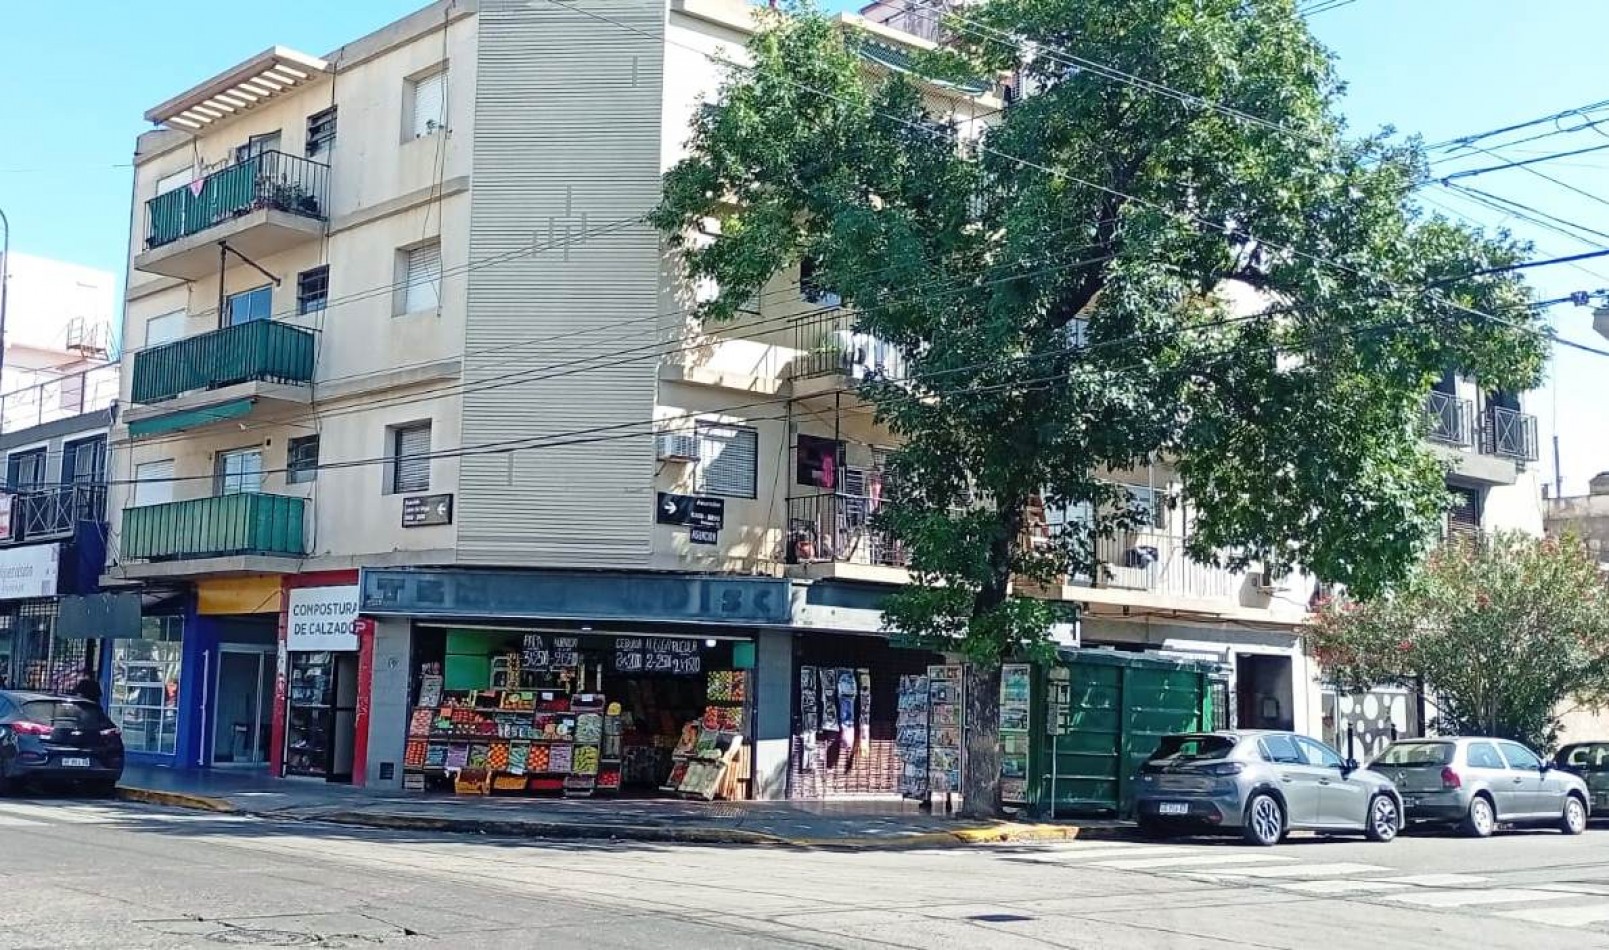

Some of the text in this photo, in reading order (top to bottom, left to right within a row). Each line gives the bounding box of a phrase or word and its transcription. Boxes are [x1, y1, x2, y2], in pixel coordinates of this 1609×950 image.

[293, 602, 357, 617] COMPOSTURA
[294, 621, 356, 636] DE CALZADO
